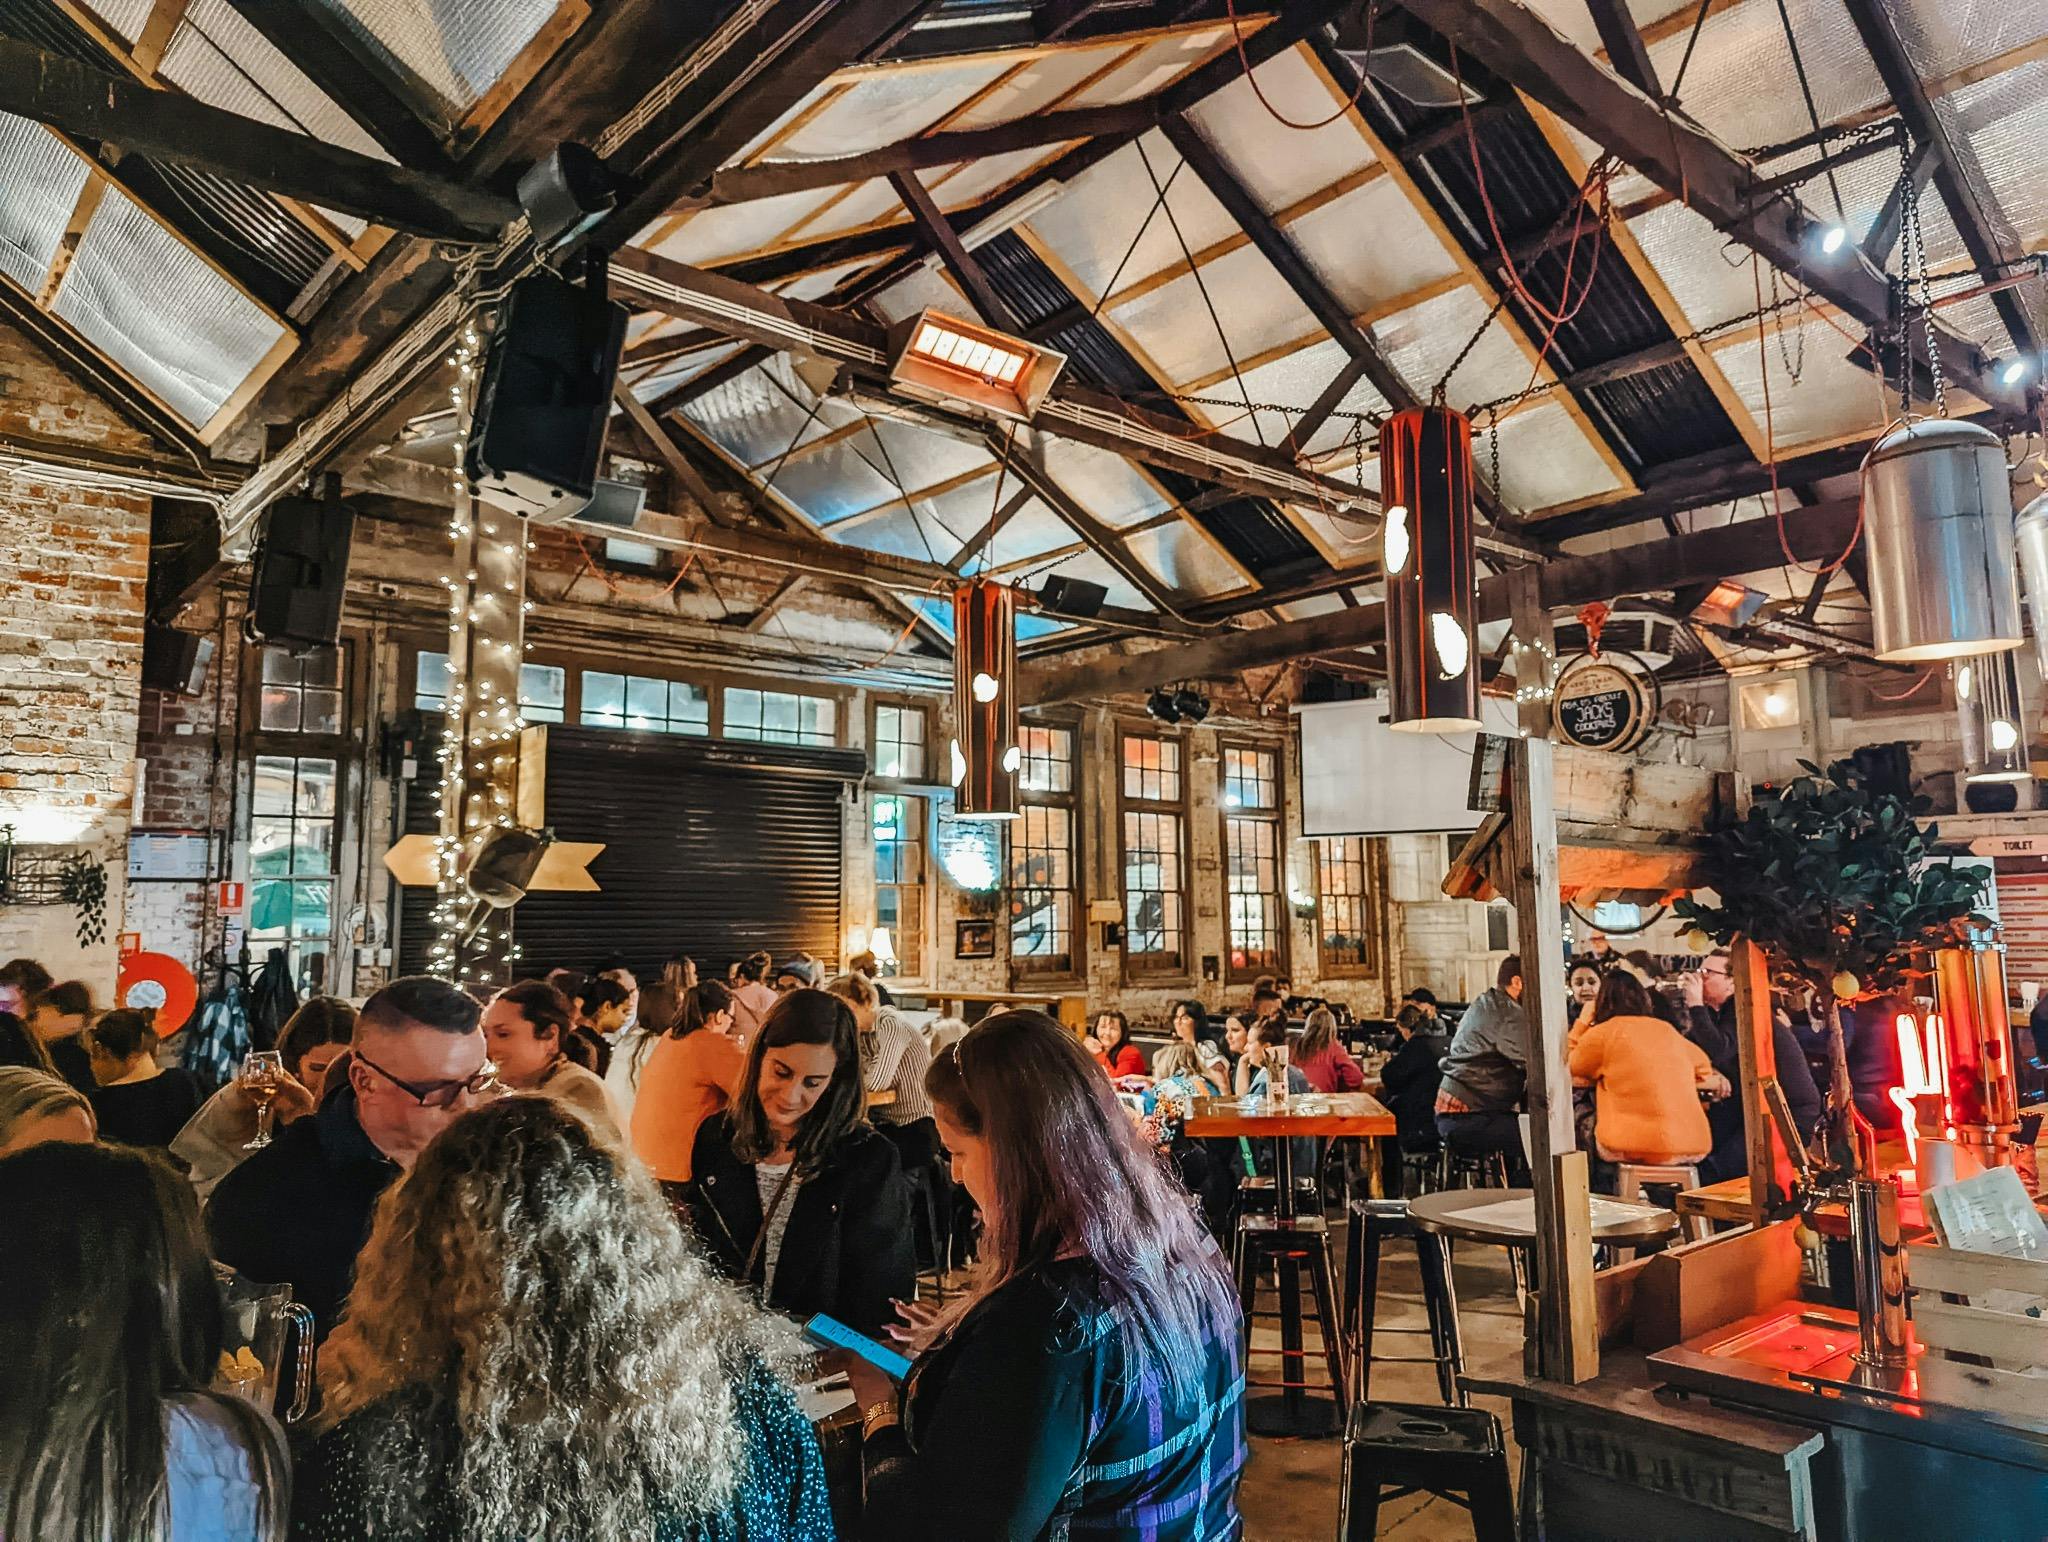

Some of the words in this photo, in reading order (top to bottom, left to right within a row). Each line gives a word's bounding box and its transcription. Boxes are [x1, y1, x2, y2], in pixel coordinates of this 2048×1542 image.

[1576, 702, 1614, 723] JACKS
[1575, 719, 1616, 732] COCKTAILS
[2003, 840, 2033, 850] TOILET
